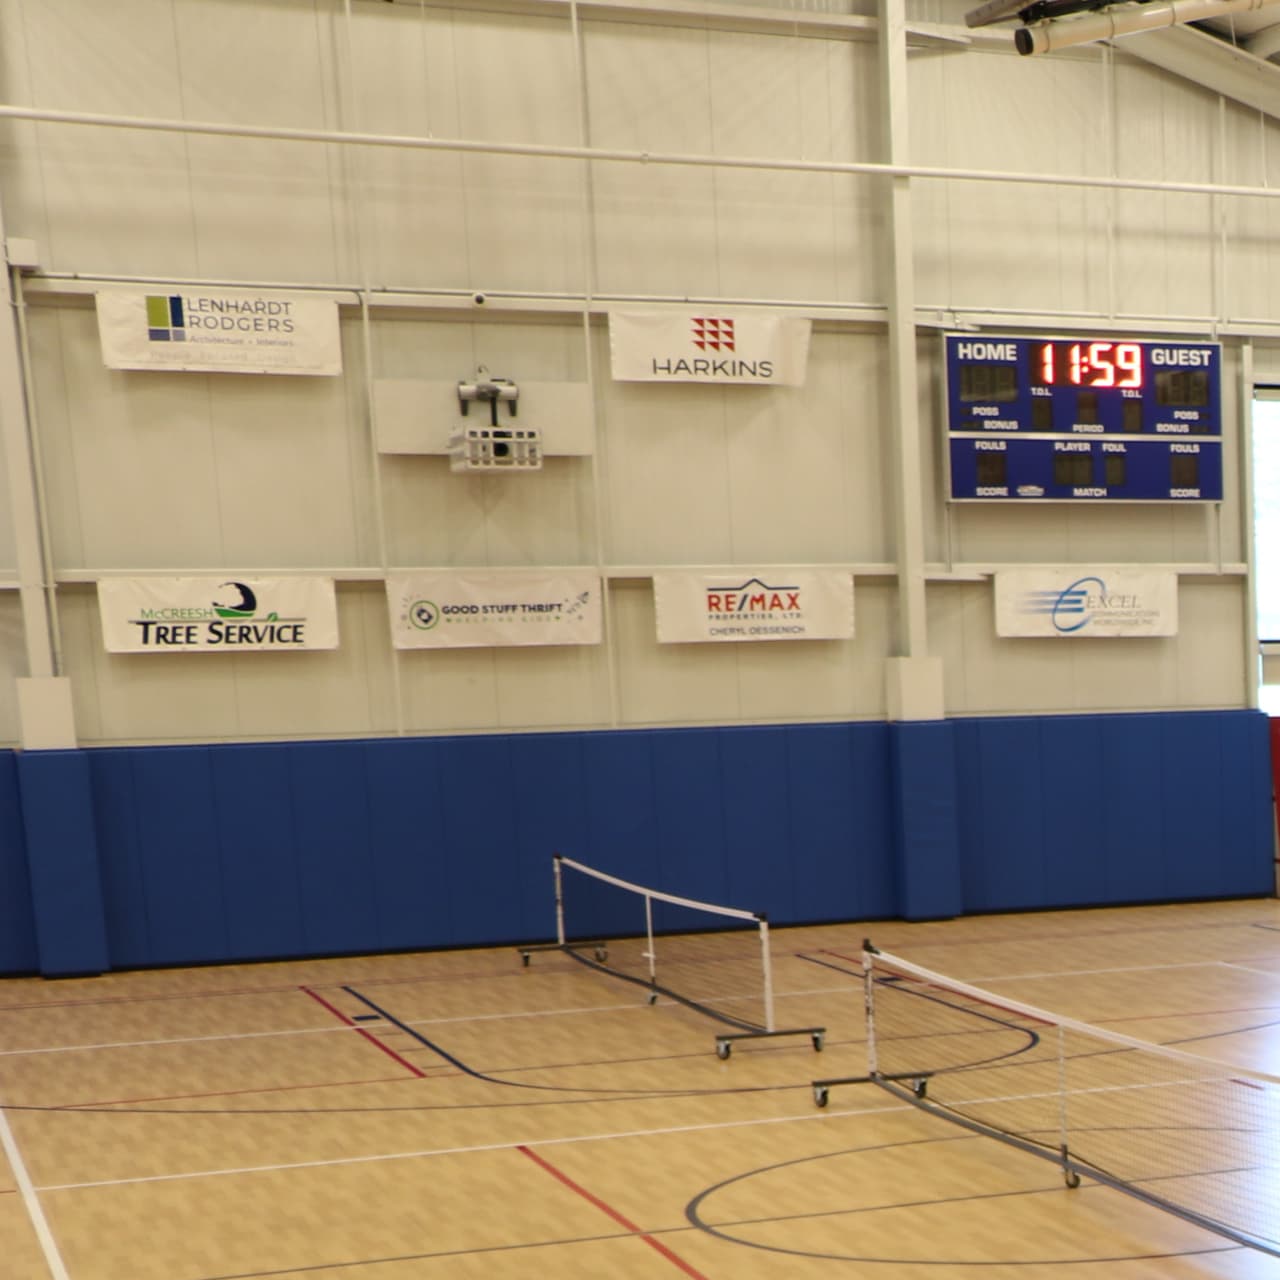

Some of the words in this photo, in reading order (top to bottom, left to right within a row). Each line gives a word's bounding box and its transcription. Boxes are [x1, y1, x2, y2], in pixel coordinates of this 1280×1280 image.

[187, 298, 292, 315] LENHARDT
[188, 315, 294, 333] RODGERS
[652, 358, 773, 378] HARKINS
[958, 343, 1017, 361] HOME
[1042, 342, 1143, 388] 11:59
[1151, 349, 1212, 366] GUEST
[972, 406, 999, 416] POSS
[1174, 410, 1199, 420] POSS
[983, 420, 1018, 430] BONUS
[1072, 424, 1104, 433] PERIOD
[1156, 423, 1189, 433] BONUS
[975, 441, 1006, 450] FOULS
[1055, 442, 1091, 452] PLAYER
[1102, 443, 1127, 452] FOUL
[1170, 444, 1200, 453] FOULS
[976, 486, 1008, 497] SCORE
[1073, 488, 1107, 497] MATCH
[1170, 488, 1200, 498] SCORE
[707, 593, 801, 612] RE/MAX
[1087, 594, 1141, 609] EXCEL
[140, 607, 214, 620] McCREESH
[441, 605, 479, 614] GOOD
[482, 604, 517, 614] STUFF
[520, 603, 562, 613] THRIFT
[136, 621, 198, 644] TREE
[207, 620, 305, 644] SERVICE
